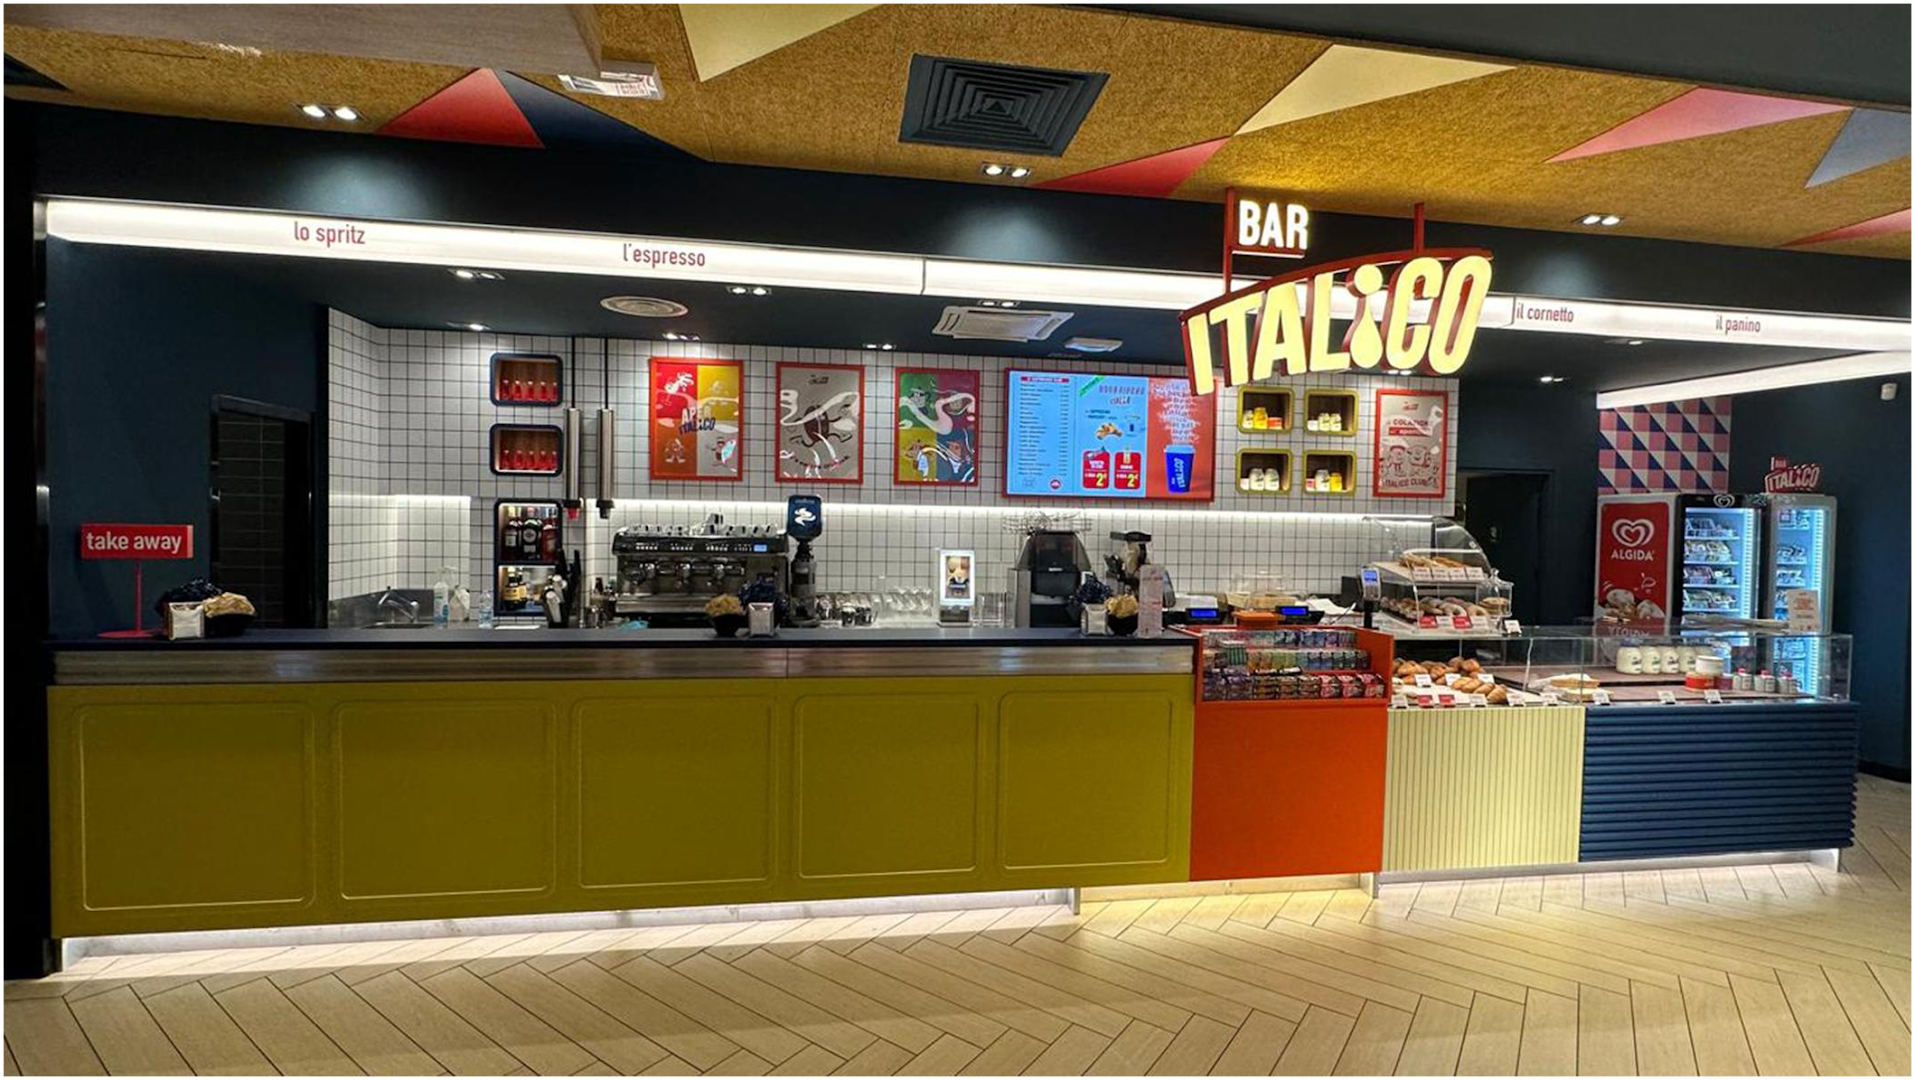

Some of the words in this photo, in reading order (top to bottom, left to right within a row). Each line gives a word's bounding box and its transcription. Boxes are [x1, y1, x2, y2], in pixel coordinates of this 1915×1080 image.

[294, 220, 310, 241] lo
[315, 223, 366, 248] spritz
[1239, 200, 1309, 249] BAR
[623, 243, 706, 269] l'espresso
[1516, 303, 1524, 320] il
[1527, 305, 1574, 323] cornetto
[1715, 314, 1723, 331] il
[1725, 317, 1761, 335] panino
[86, 531, 129, 550] take
[134, 536, 182, 554] away
[1611, 549, 1654, 561] ALGIDA
